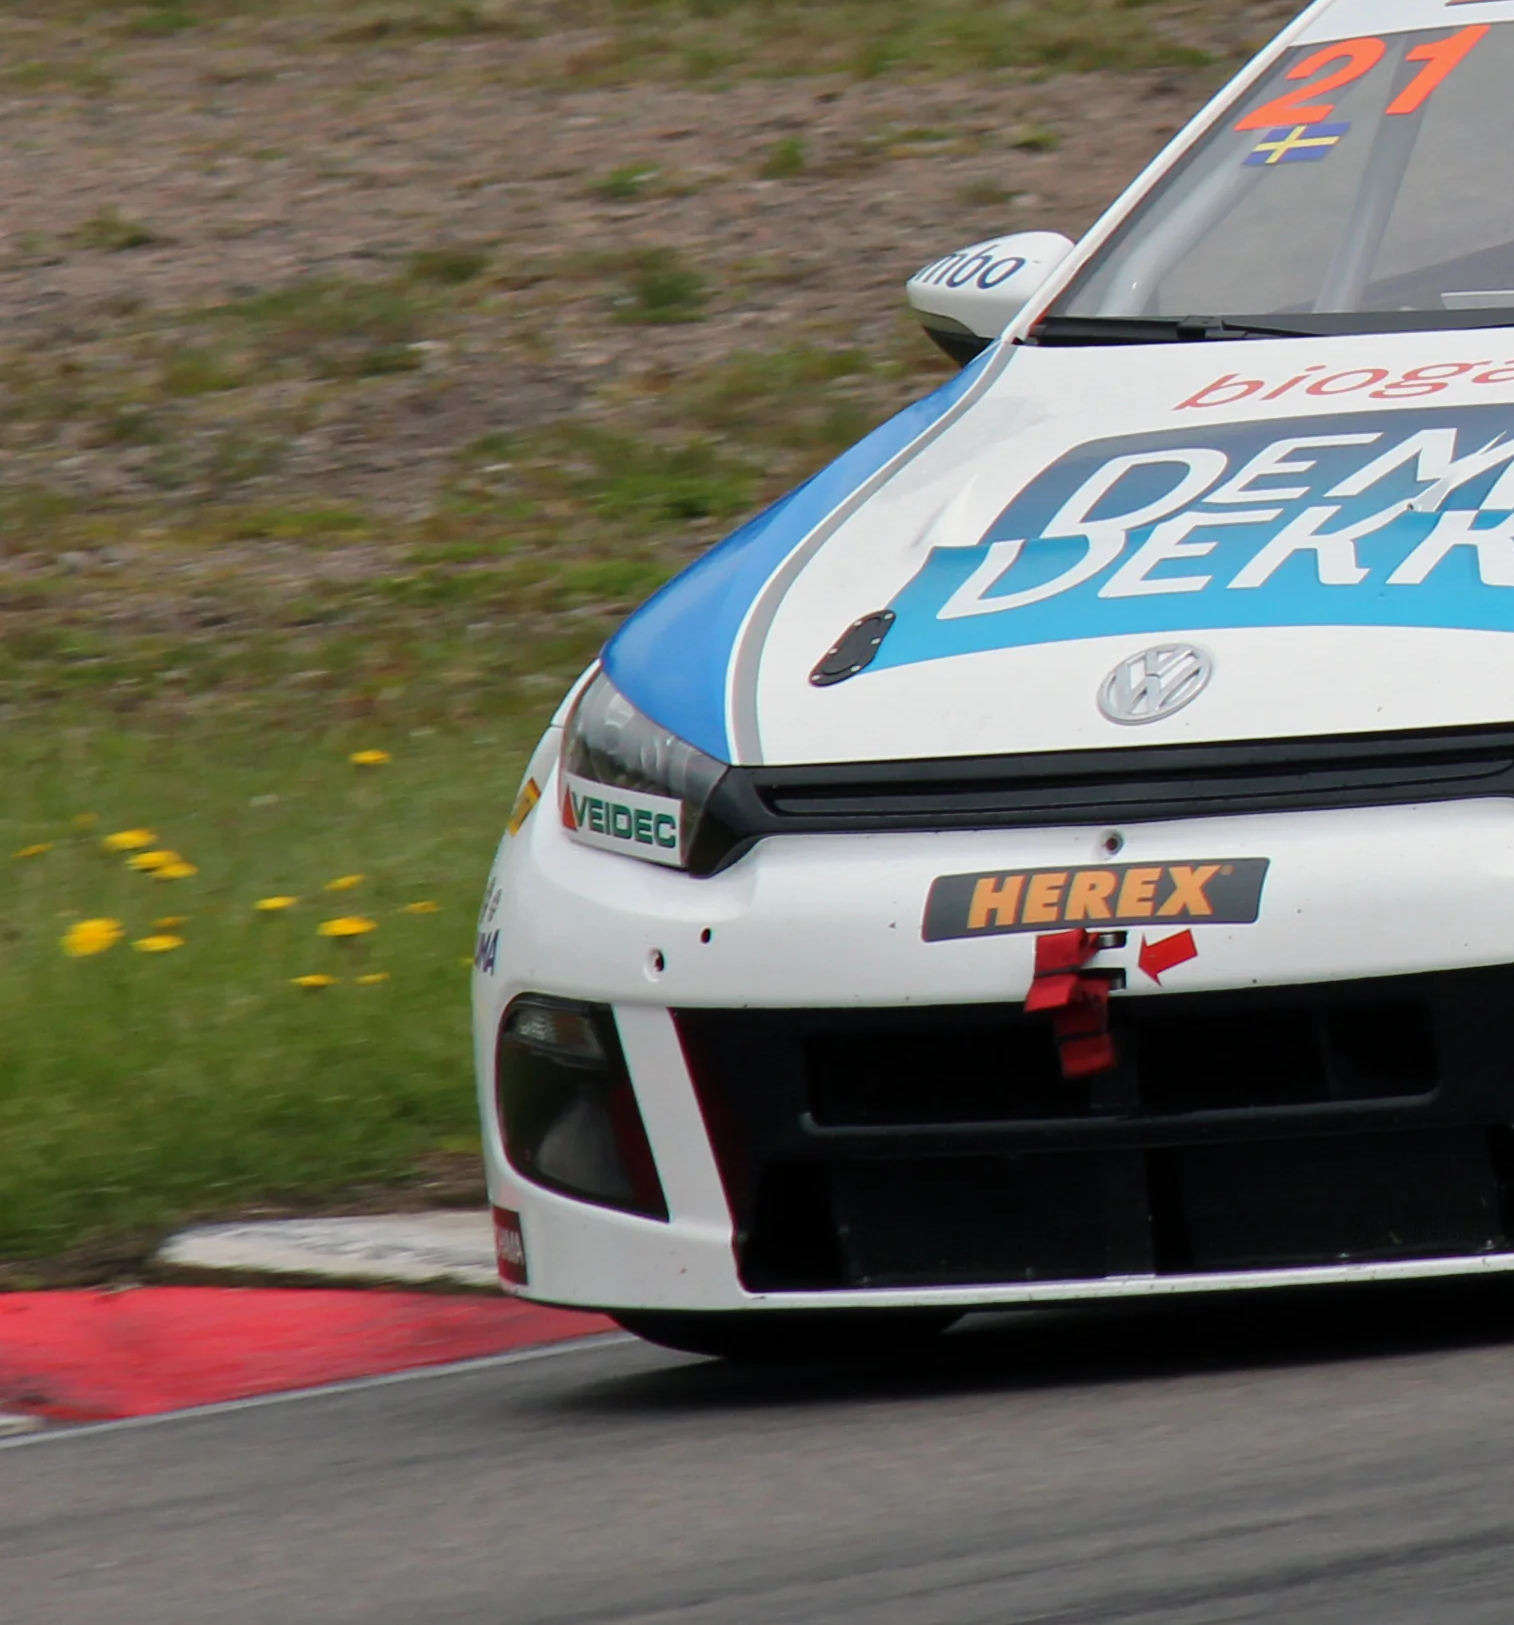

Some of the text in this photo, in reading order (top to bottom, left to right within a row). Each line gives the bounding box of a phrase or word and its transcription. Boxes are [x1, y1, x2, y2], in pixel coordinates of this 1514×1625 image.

[1235, 24, 1491, 131] 21
[912, 243, 1027, 290] mbo
[572, 791, 676, 849] VEIDEC
[967, 866, 1213, 928] HEREX
